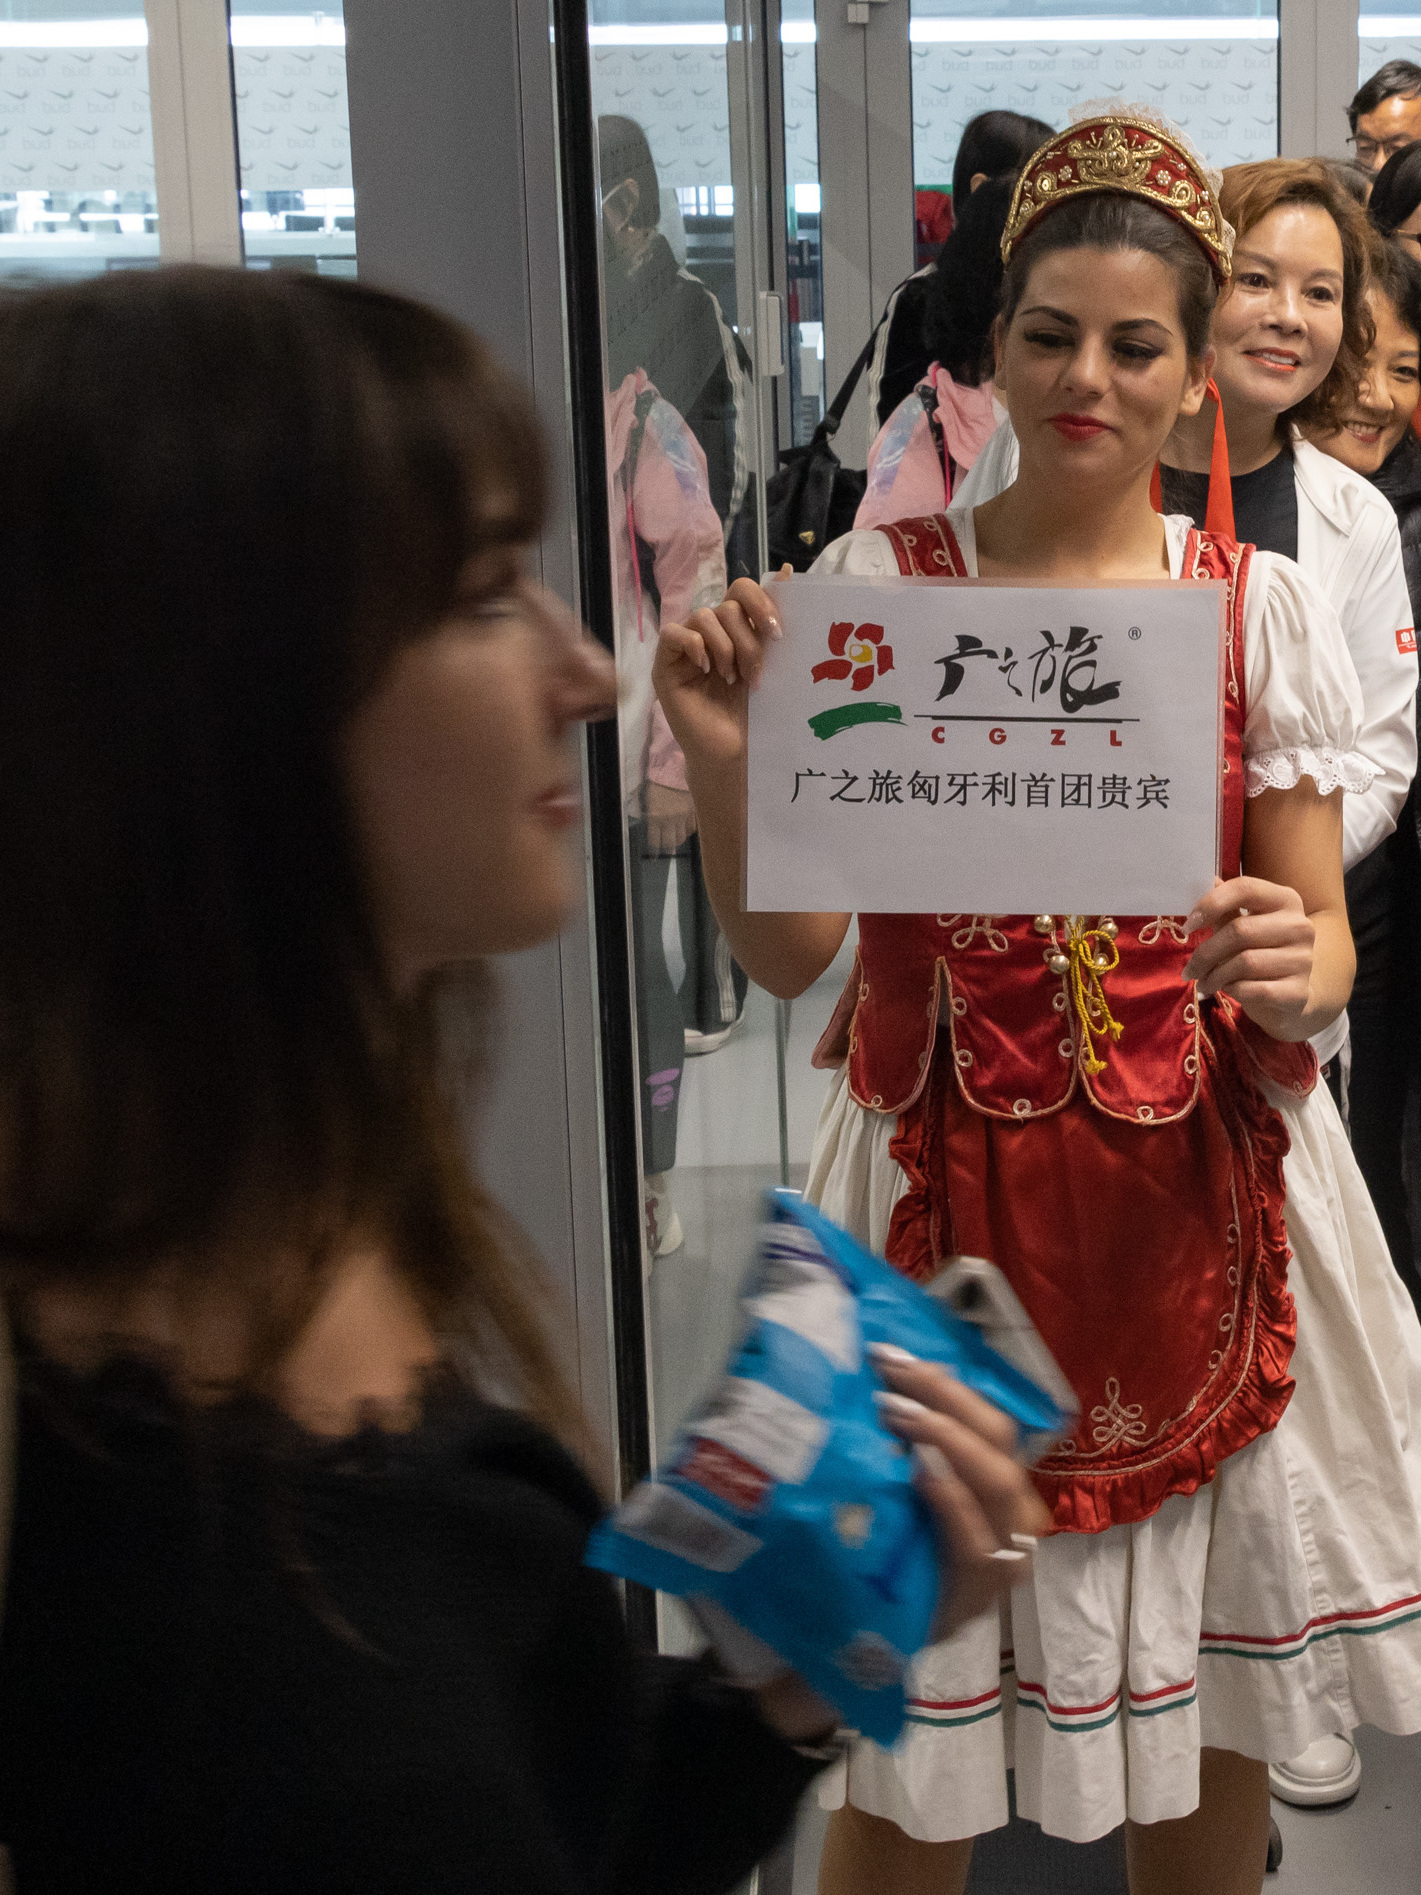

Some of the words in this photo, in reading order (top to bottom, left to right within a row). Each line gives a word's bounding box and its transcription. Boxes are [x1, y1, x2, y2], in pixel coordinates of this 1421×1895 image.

[942, 58, 969, 72] bud
[985, 58, 1013, 72] bud
[1028, 58, 1056, 71] bud
[1072, 57, 1099, 71] bud
[1115, 57, 1142, 70] bud
[1157, 56, 1185, 70] bud
[1200, 56, 1228, 70] bud
[1243, 56, 1271, 69] bud
[920, 94, 948, 107] bud
[964, 94, 992, 107] bud
[1007, 93, 1035, 107] bud
[1179, 92, 1207, 105] bud
[1222, 92, 1250, 105] bud
[1201, 128, 1228, 141] bud
[1243, 127, 1271, 140] bud
[934, 626, 1123, 713] 广之旅
[790, 768, 1171, 811] 广之旅匈牙利首团贵宾
